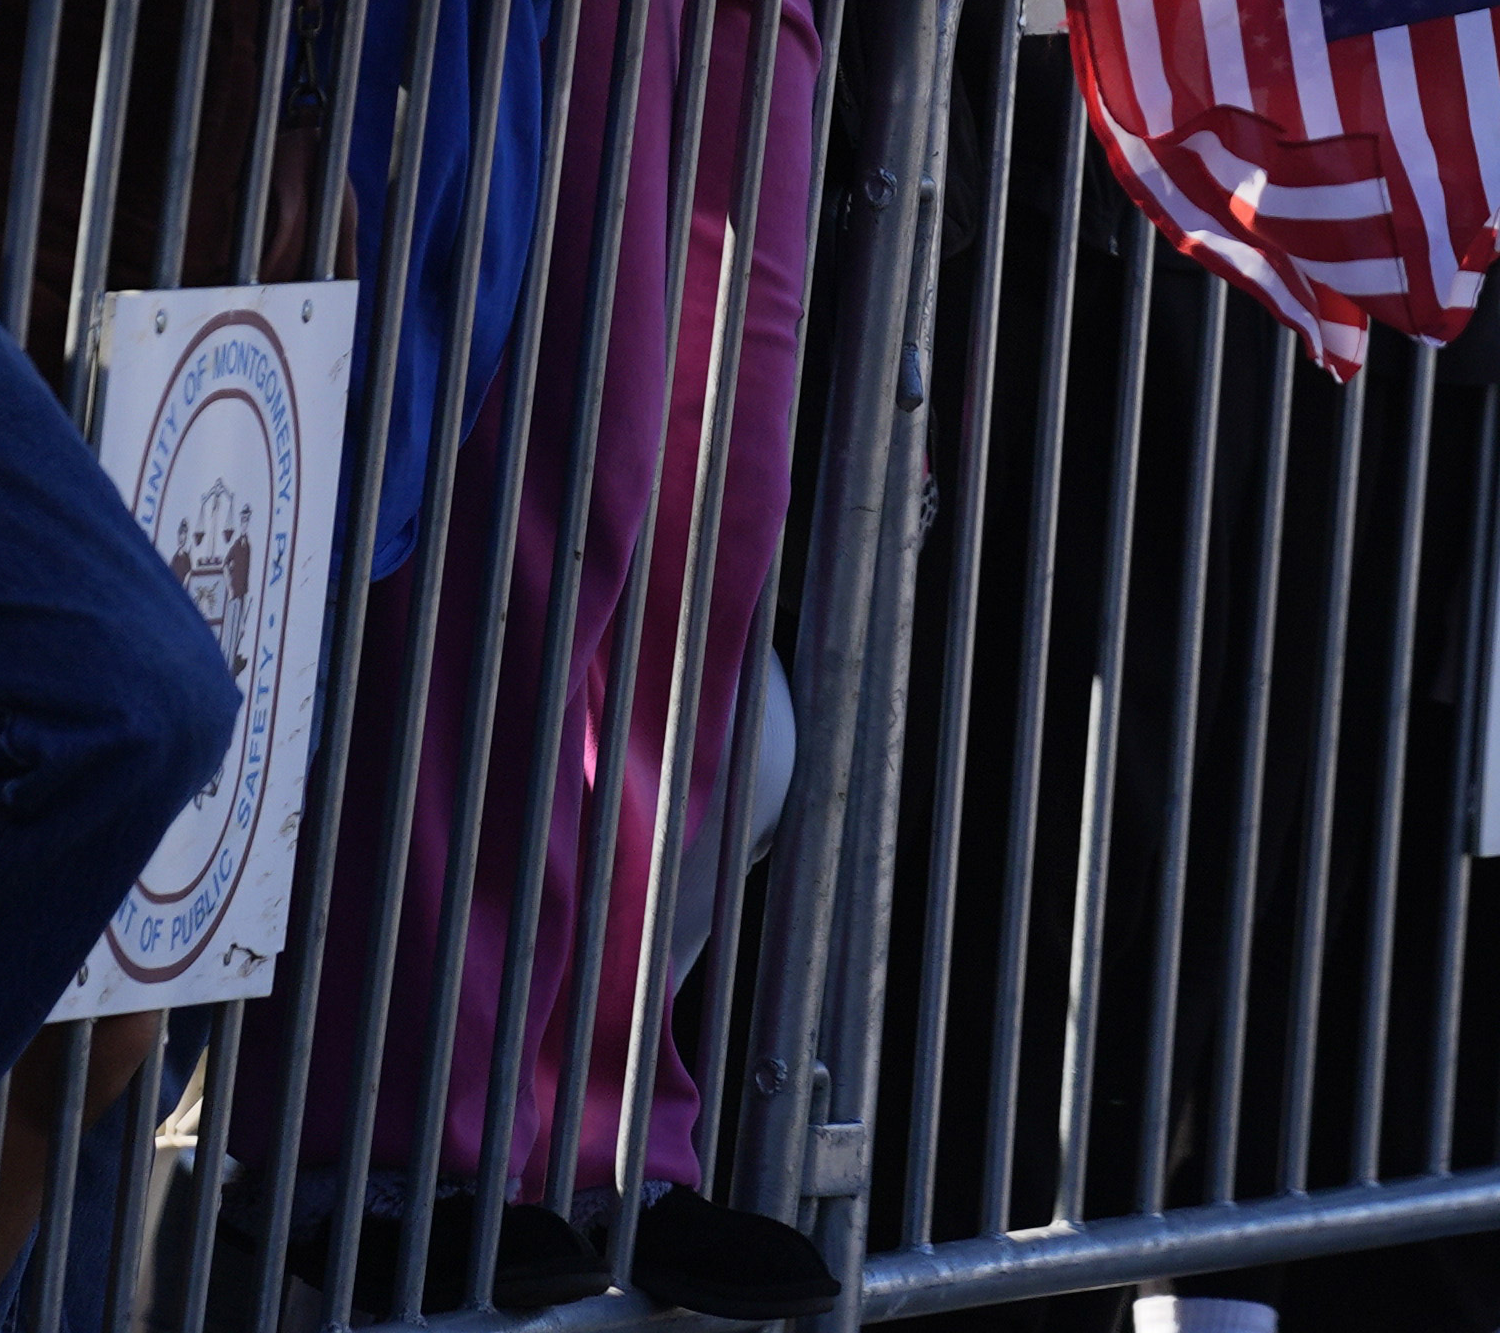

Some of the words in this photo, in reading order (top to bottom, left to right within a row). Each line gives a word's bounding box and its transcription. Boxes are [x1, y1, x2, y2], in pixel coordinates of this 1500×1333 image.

[142, 402, 181, 525] UNTY
[183, 354, 207, 406] OF
[139, 917, 164, 953] OF
[169, 847, 234, 952] PUBLIC
[236, 644, 275, 831] SAFETY
